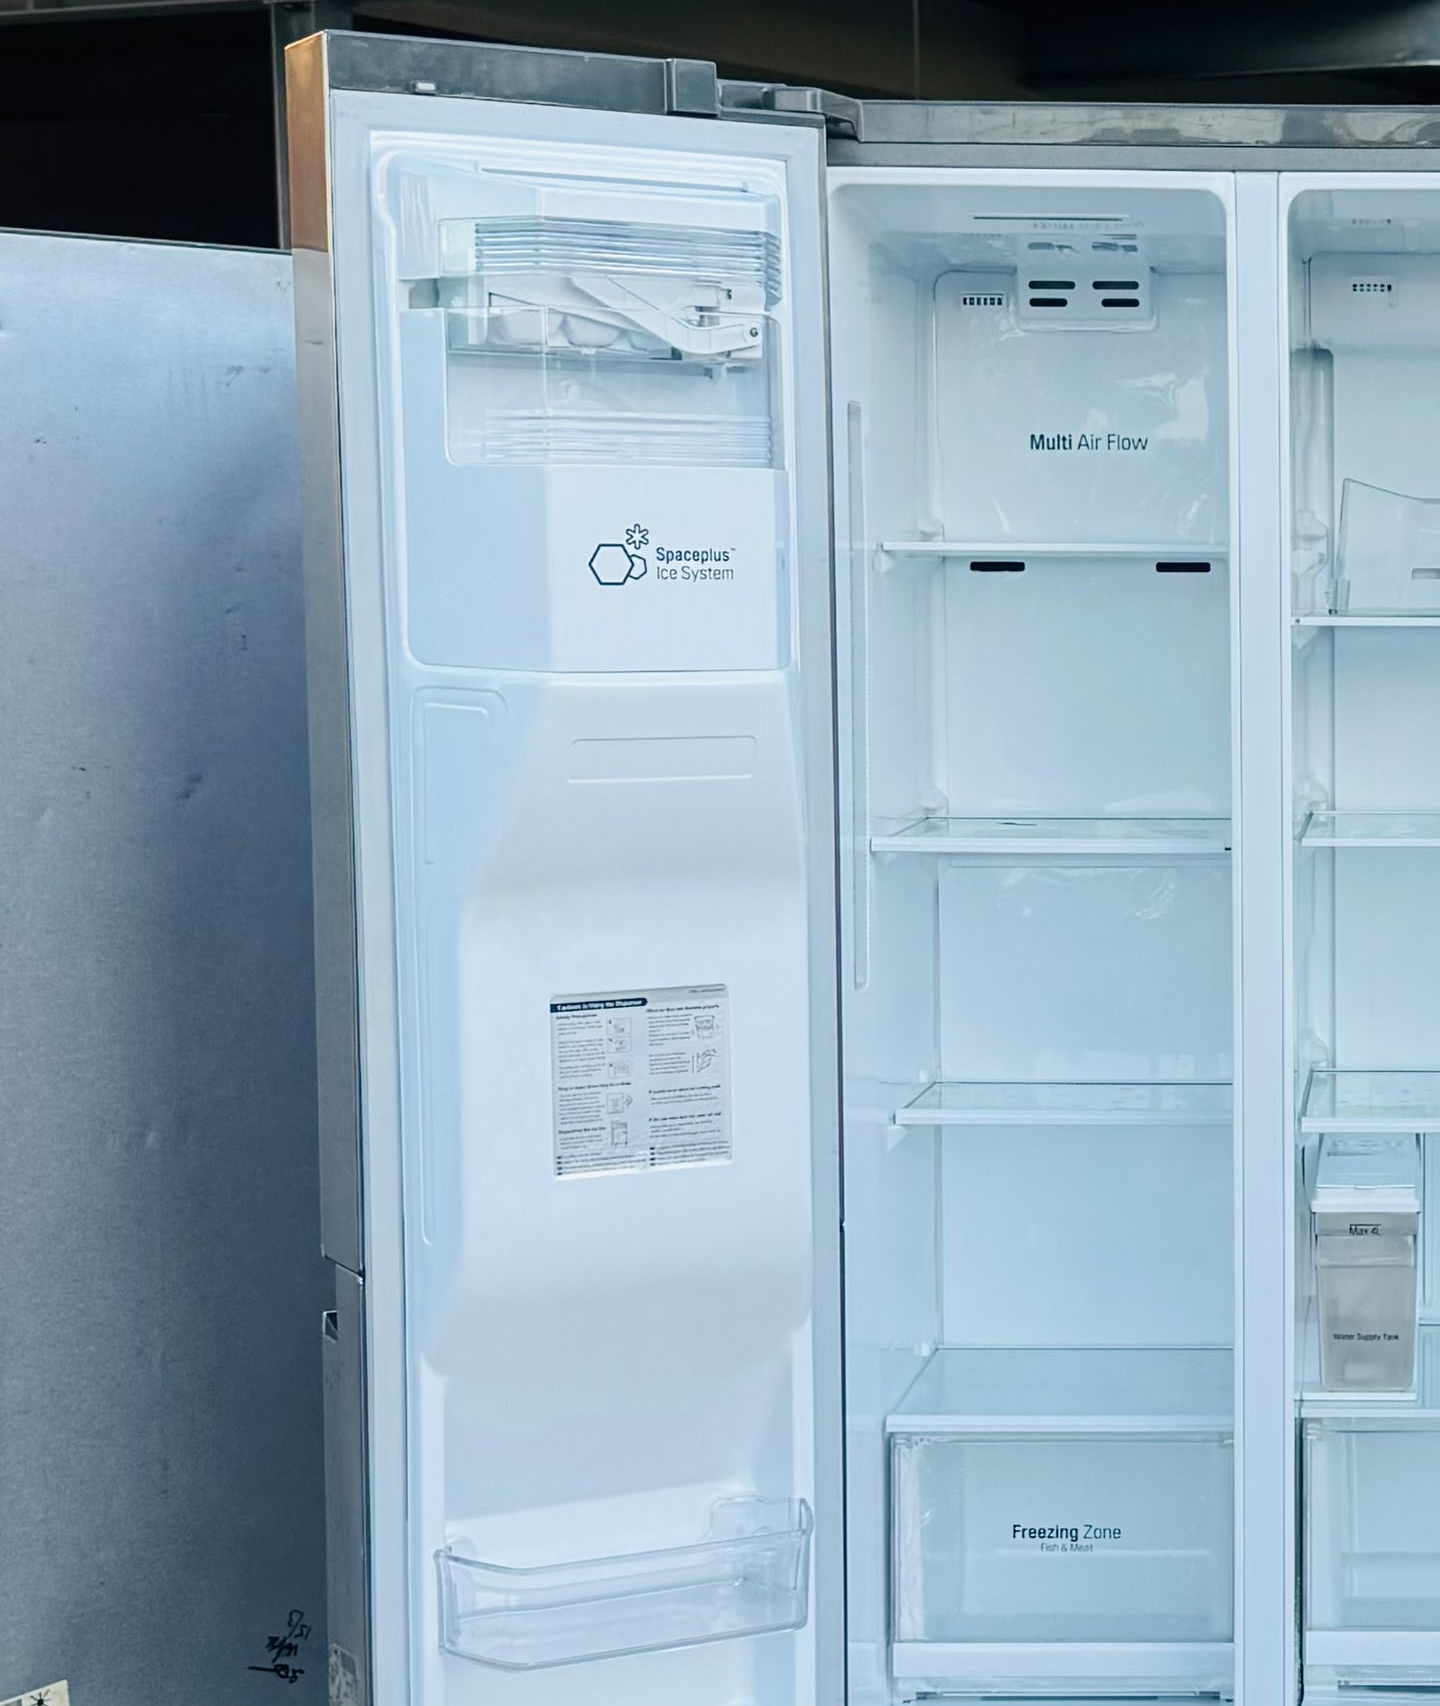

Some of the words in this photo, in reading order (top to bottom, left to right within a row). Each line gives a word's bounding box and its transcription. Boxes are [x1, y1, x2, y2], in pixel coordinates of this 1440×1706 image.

[1031, 433, 1073, 451] Multi
[1078, 433, 1102, 451] Air
[1107, 433, 1149, 451] Flow
[656, 565, 678, 580] Ice
[681, 565, 734, 583] System
[1349, 1225, 1369, 1236] Max
[1333, 1333, 1355, 1341] Water
[1356, 1333, 1382, 1342] Supply
[1383, 1333, 1399, 1341] Tank
[1013, 1524, 1079, 1542] Freezing
[1083, 1524, 1122, 1539] Zone
[1040, 1542, 1059, 1552] Fish
[1060, 1543, 1068, 1552] &
[1069, 1543, 1094, 1552] Meat
